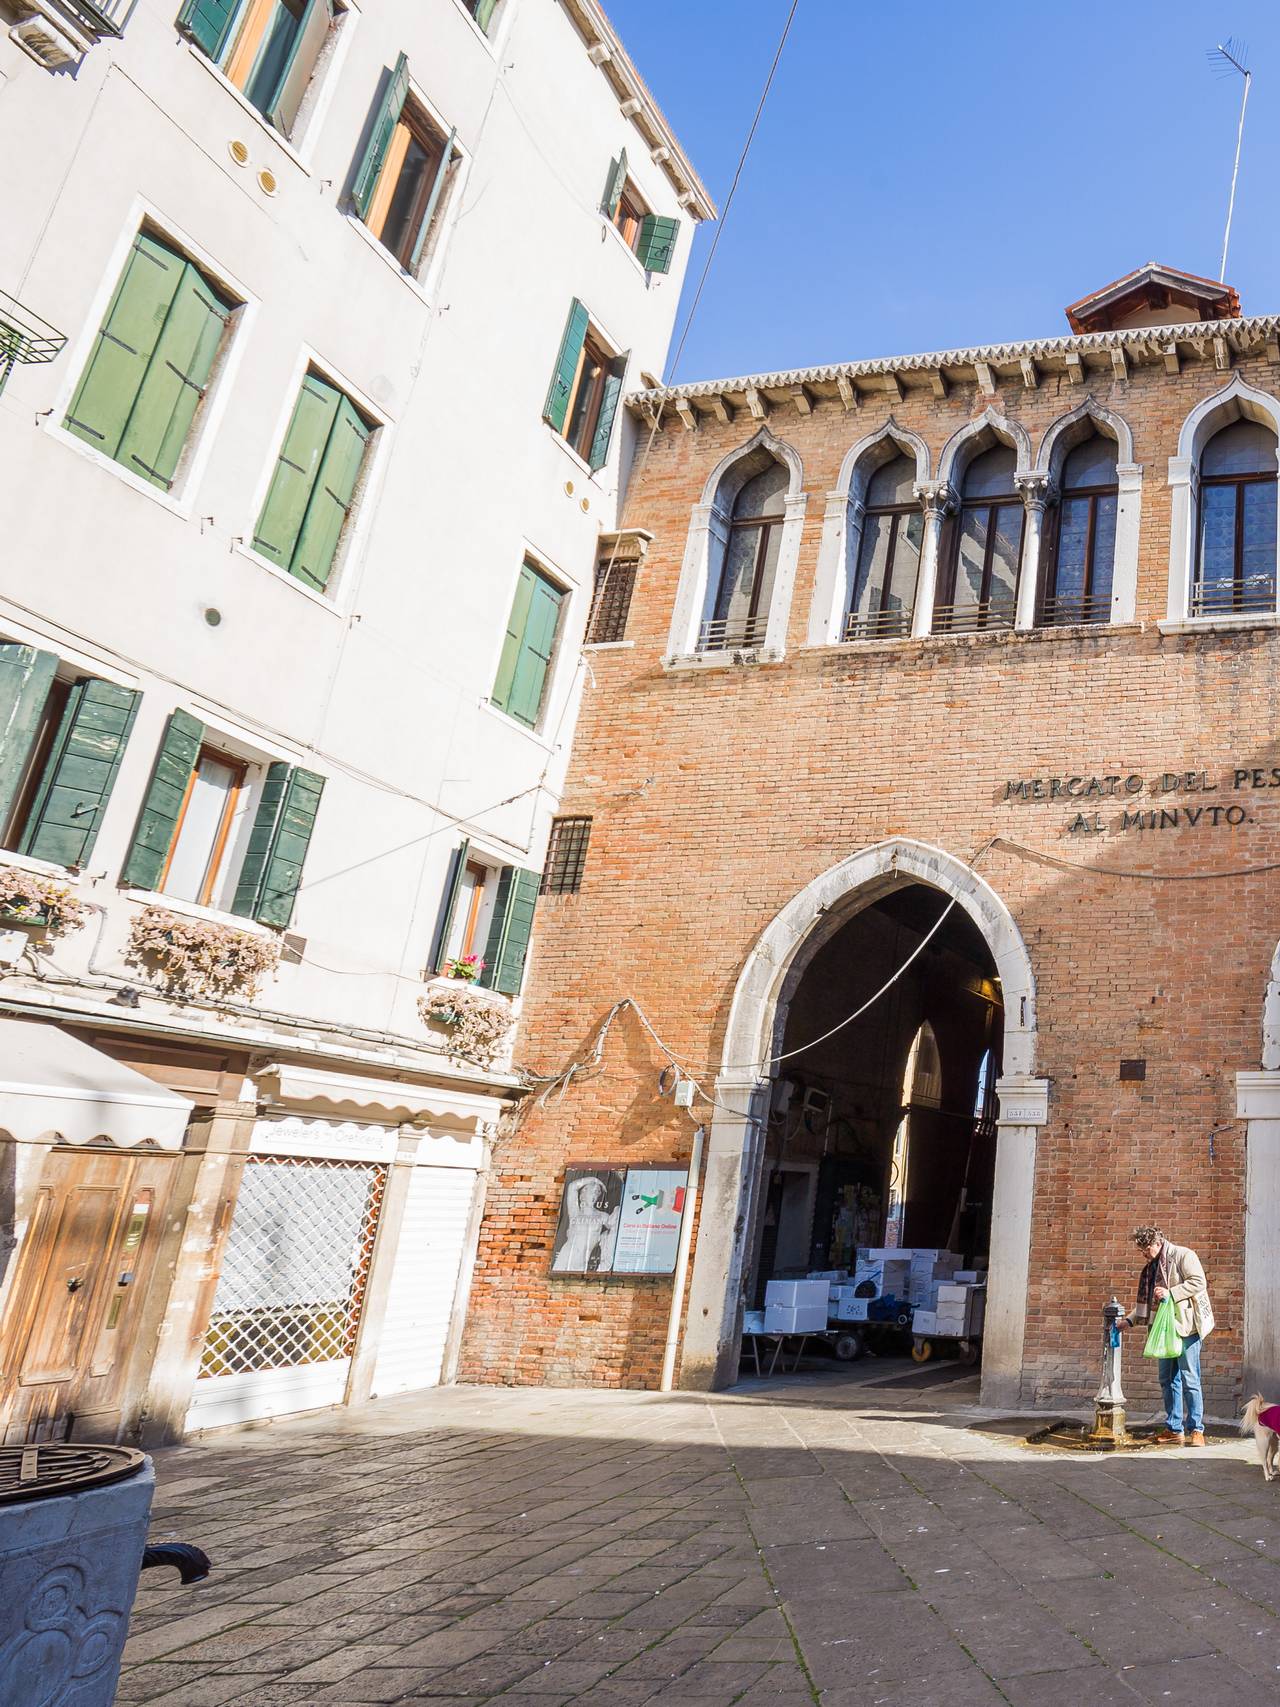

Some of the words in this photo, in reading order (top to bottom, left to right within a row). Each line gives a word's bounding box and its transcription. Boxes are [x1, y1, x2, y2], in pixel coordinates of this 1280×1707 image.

[1003, 774, 1144, 800] MERCATO
[1161, 771, 1217, 792] DEL
[1068, 811, 1108, 832] AL
